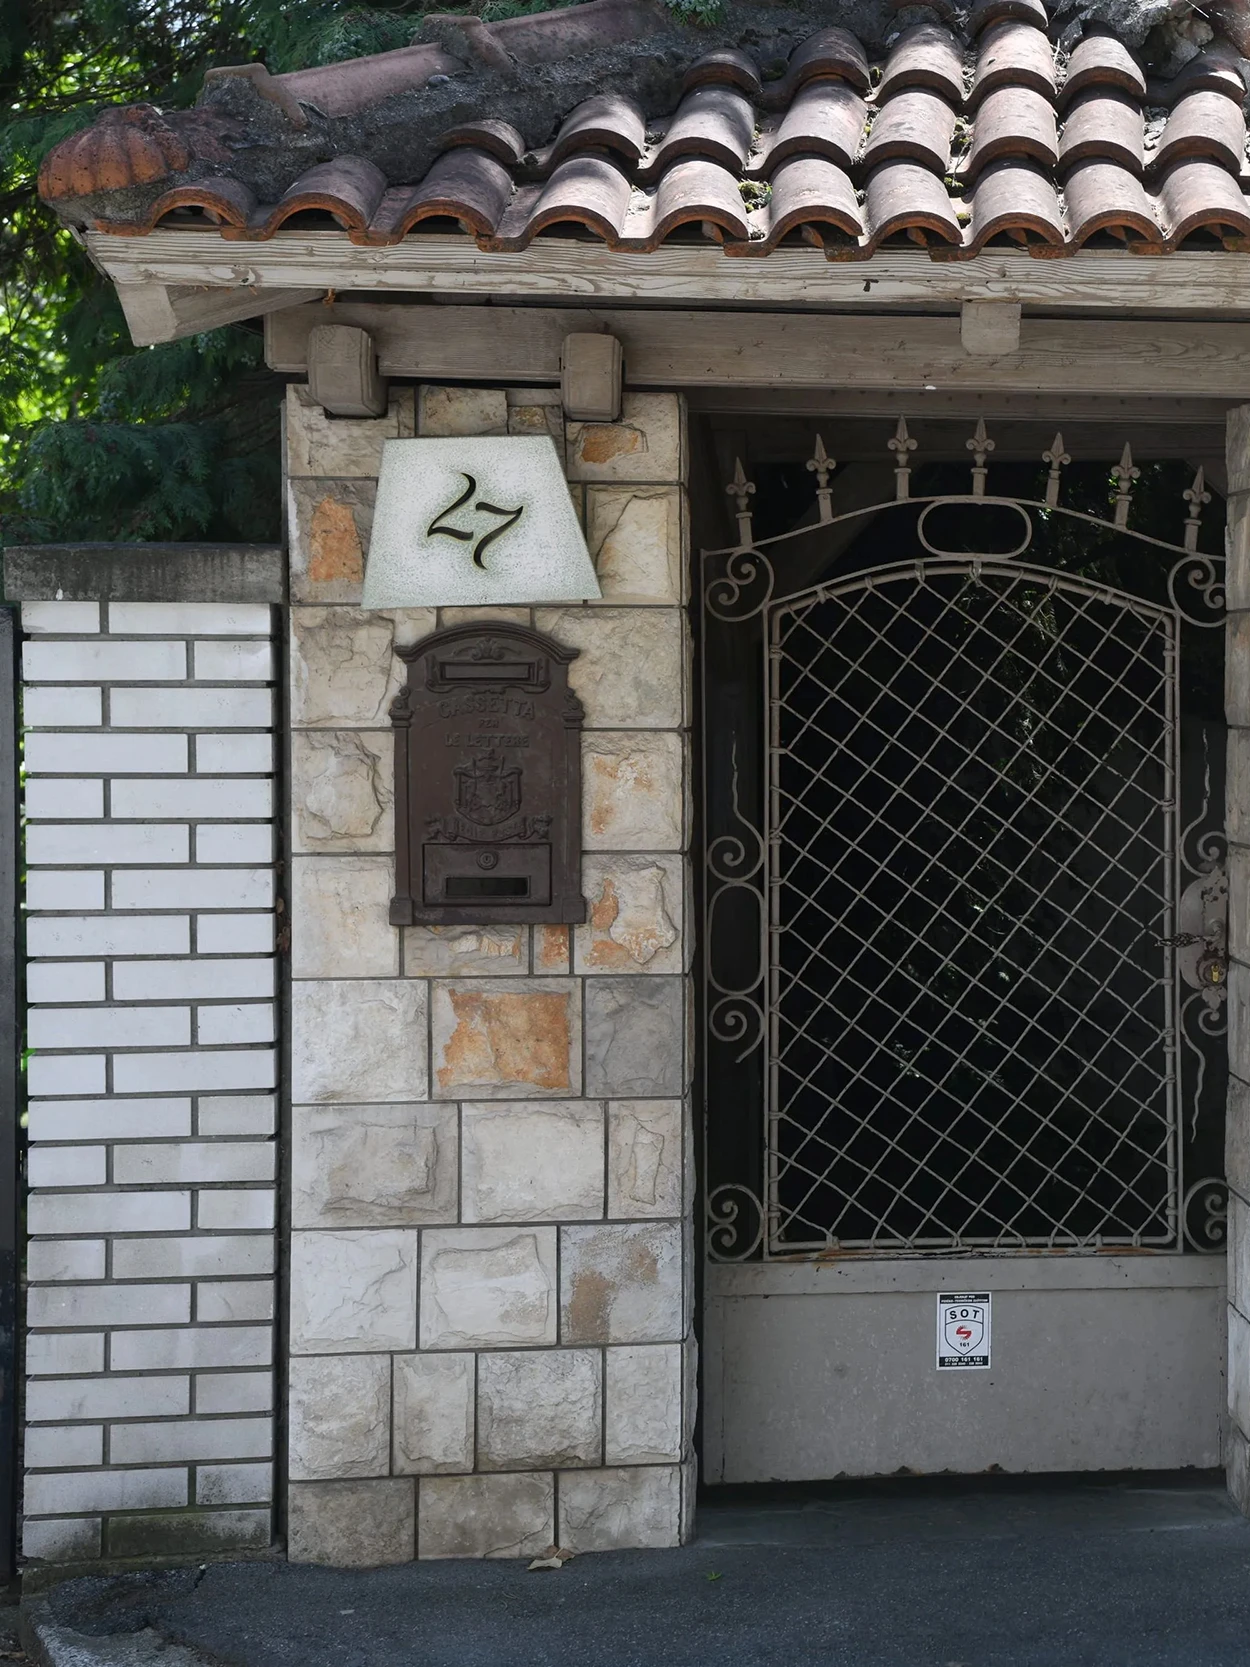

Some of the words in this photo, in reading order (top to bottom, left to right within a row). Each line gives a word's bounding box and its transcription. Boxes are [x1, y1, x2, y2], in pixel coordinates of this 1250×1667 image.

[427, 472, 524, 570] 27
[438, 696, 536, 720] CASSETTA
[444, 733, 464, 748] LE
[466, 733, 530, 748] LETTERE
[949, 1309, 980, 1320] SOT
